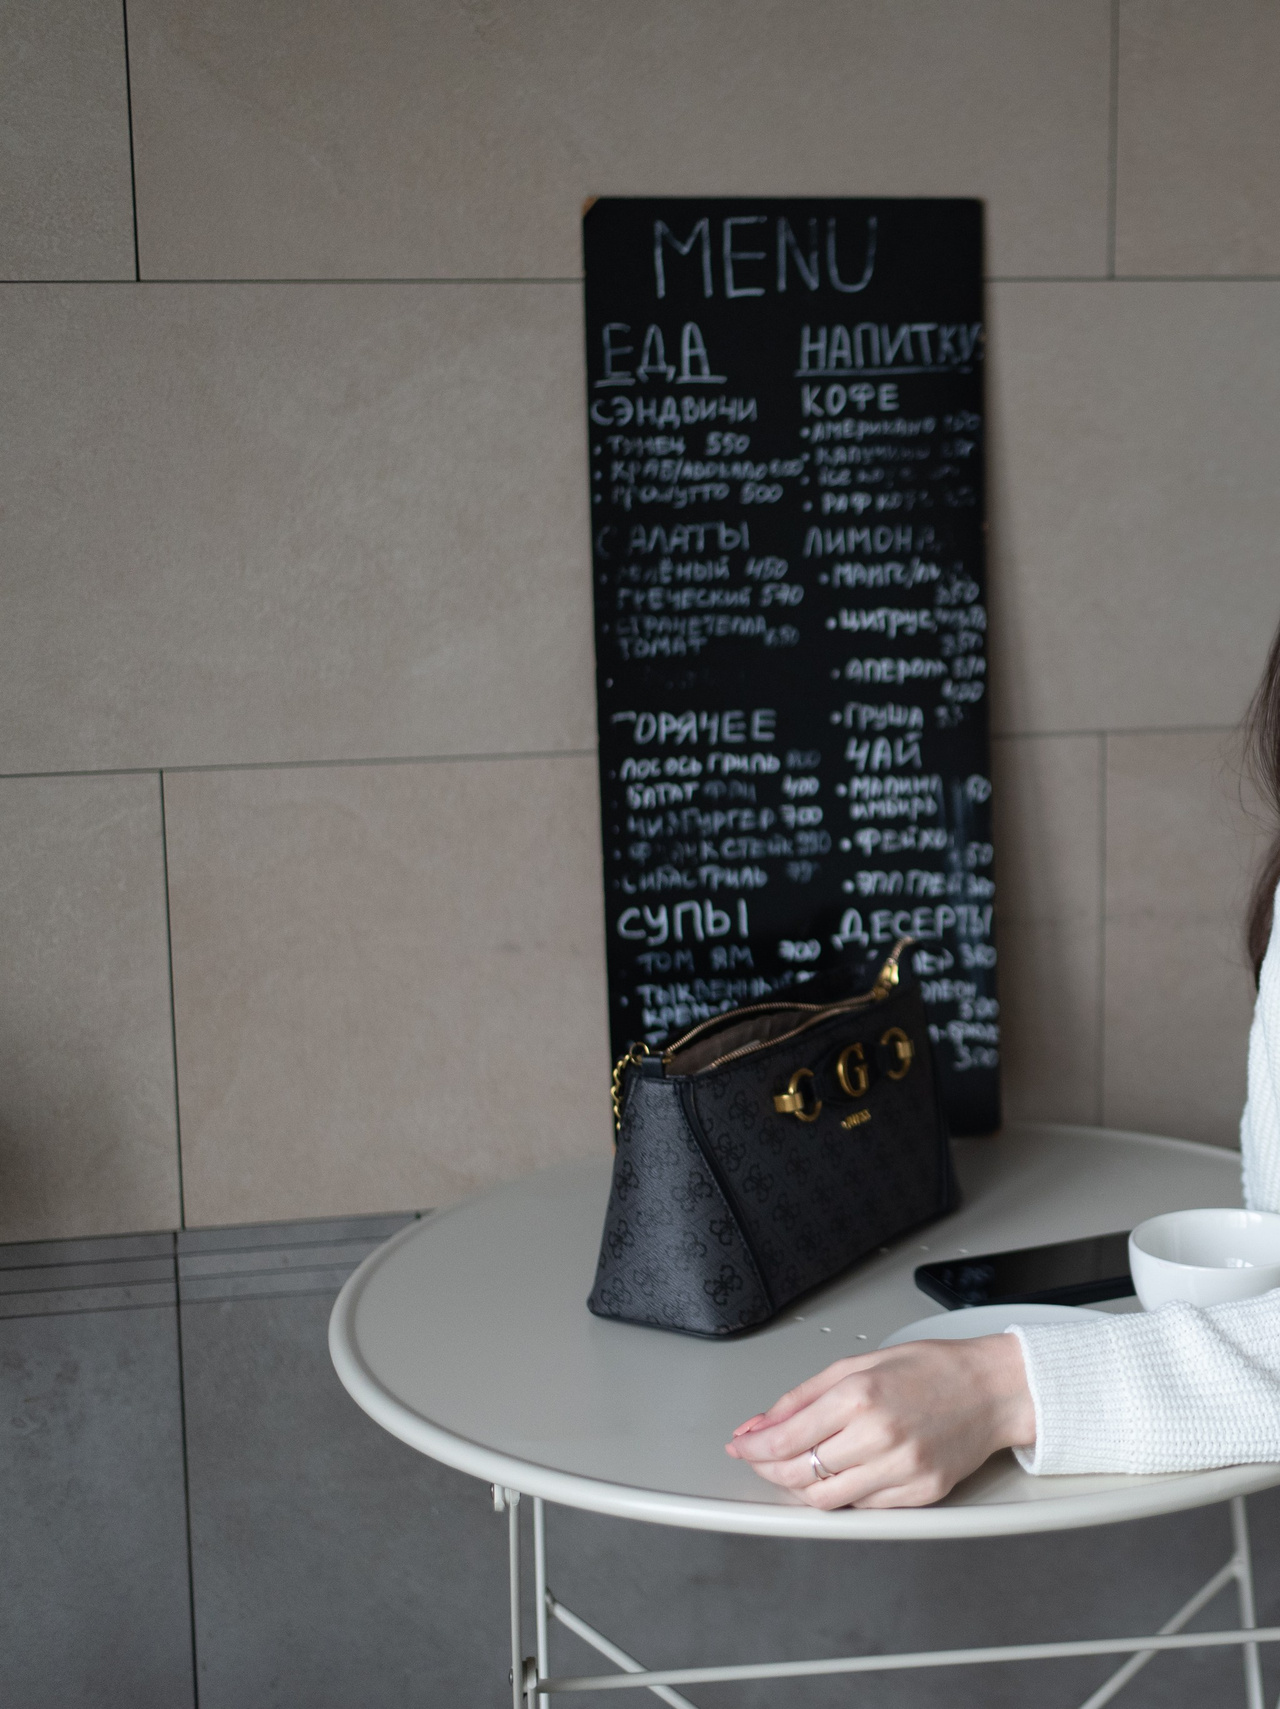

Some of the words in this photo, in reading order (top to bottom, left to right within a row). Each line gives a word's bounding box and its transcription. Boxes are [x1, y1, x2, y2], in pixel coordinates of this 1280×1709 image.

[653, 215, 877, 299] MENU
[601, 321, 712, 384] ЕДА
[591, 394, 758, 430] СЭНДВИЧИ
[801, 382, 900, 418] КОФЕ
[596, 520, 750, 559] САЛАТЫ
[843, 701, 924, 732] ГРУША
[705, 750, 781, 777] ГРИЛЬ
[844, 731, 923, 773] ЧАЙ
[626, 780, 700, 811] БАТАТ
[616, 897, 750, 947] СУПЫ
[830, 903, 994, 951] ДЕСЕРТЫ
[635, 948, 696, 976] ТОМ
